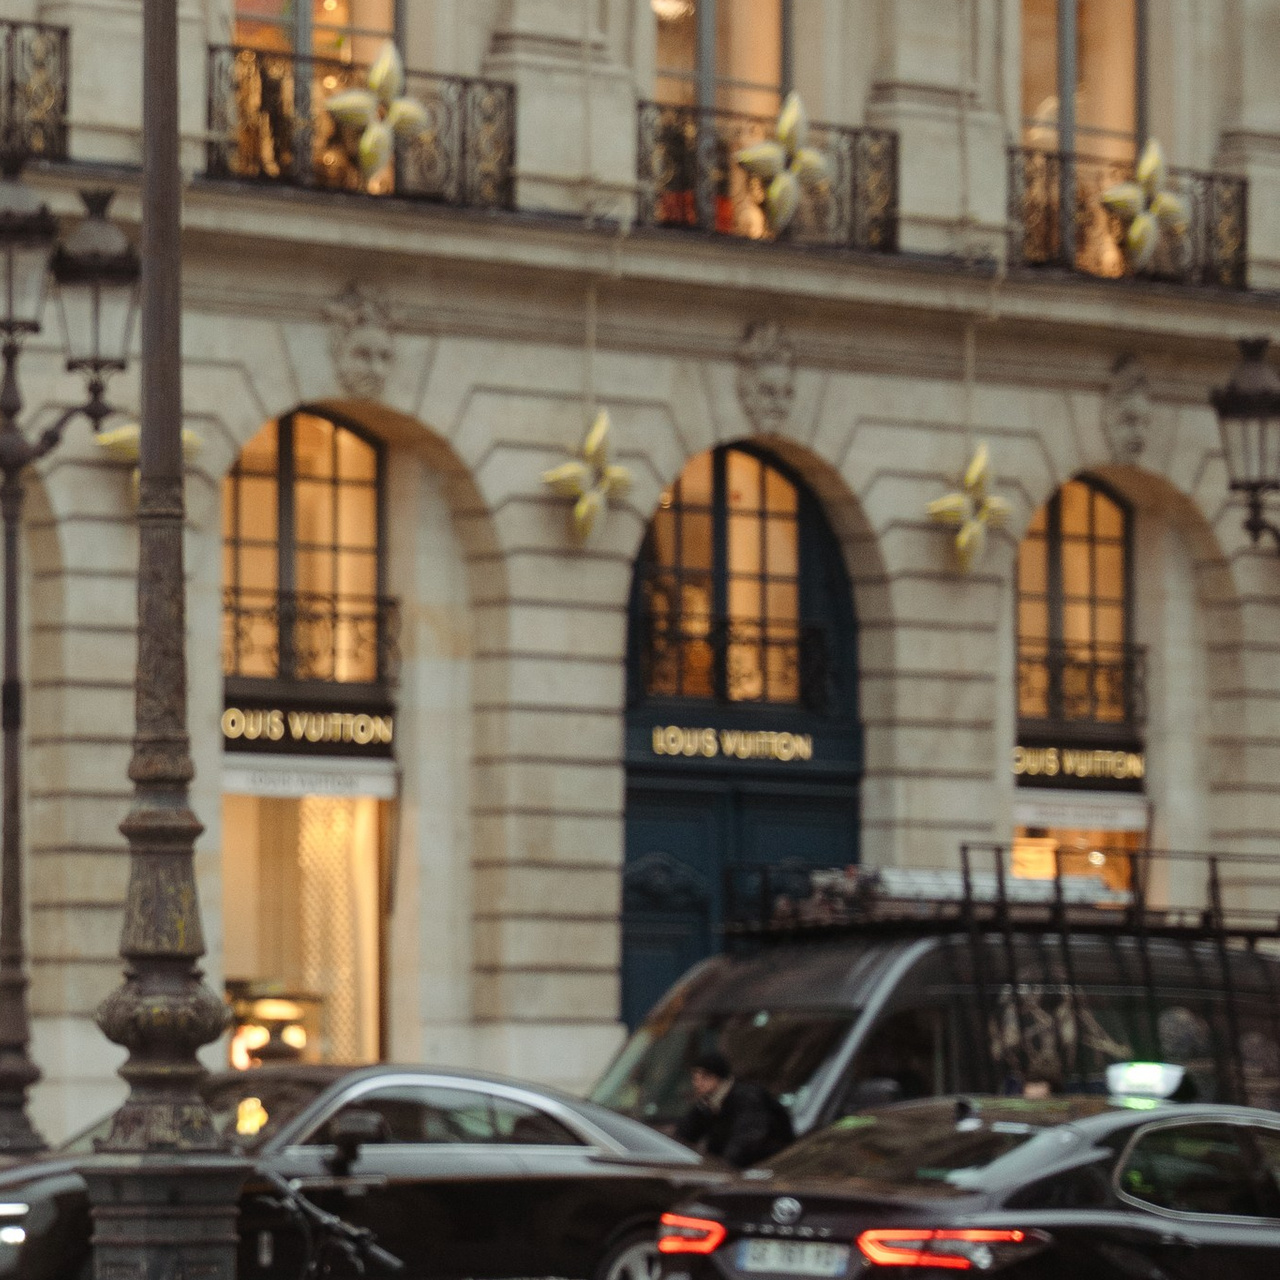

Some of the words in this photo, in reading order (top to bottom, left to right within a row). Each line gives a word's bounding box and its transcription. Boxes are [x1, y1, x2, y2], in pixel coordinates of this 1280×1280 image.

[221, 707, 285, 741] OUIS
[288, 711, 393, 745] VUITTON
[652, 726, 718, 757] LOUIS
[721, 729, 813, 761] VUITTON
[1012, 746, 1060, 776] OUIS
